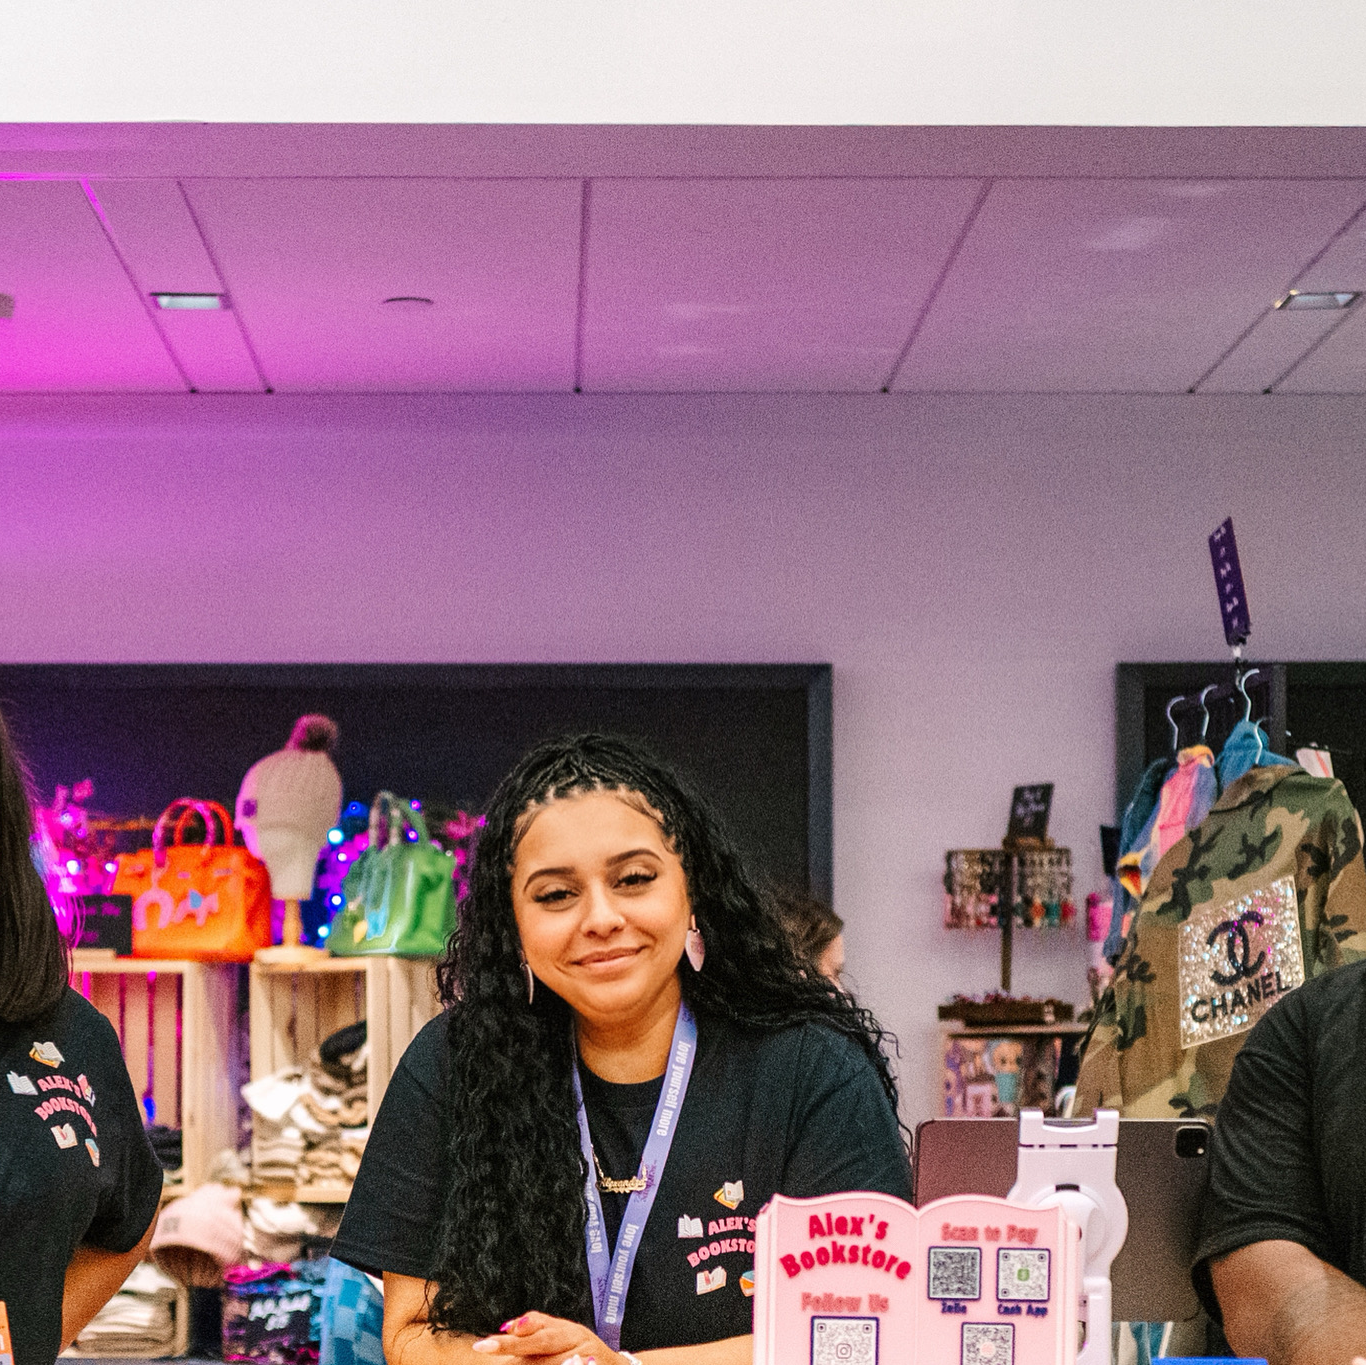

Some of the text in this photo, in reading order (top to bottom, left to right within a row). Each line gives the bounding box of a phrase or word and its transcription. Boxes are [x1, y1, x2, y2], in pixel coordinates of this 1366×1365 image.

[1191, 971, 1293, 1023] CHANEL
[37, 1075, 81, 1098] ALEX'S
[656, 1040, 691, 1136] love yourself more
[708, 1216, 756, 1236] ALEX'S
[808, 1211, 889, 1240] Alex's
[941, 1222, 1038, 1245] Scan to Pay
[687, 1238, 756, 1268] BOOKSTO
[779, 1241, 913, 1280] Bookstore
[604, 1222, 640, 1325] love yourself more
[801, 1292, 889, 1312] Follow Us
[997, 1303, 1048, 1318] Cash App
